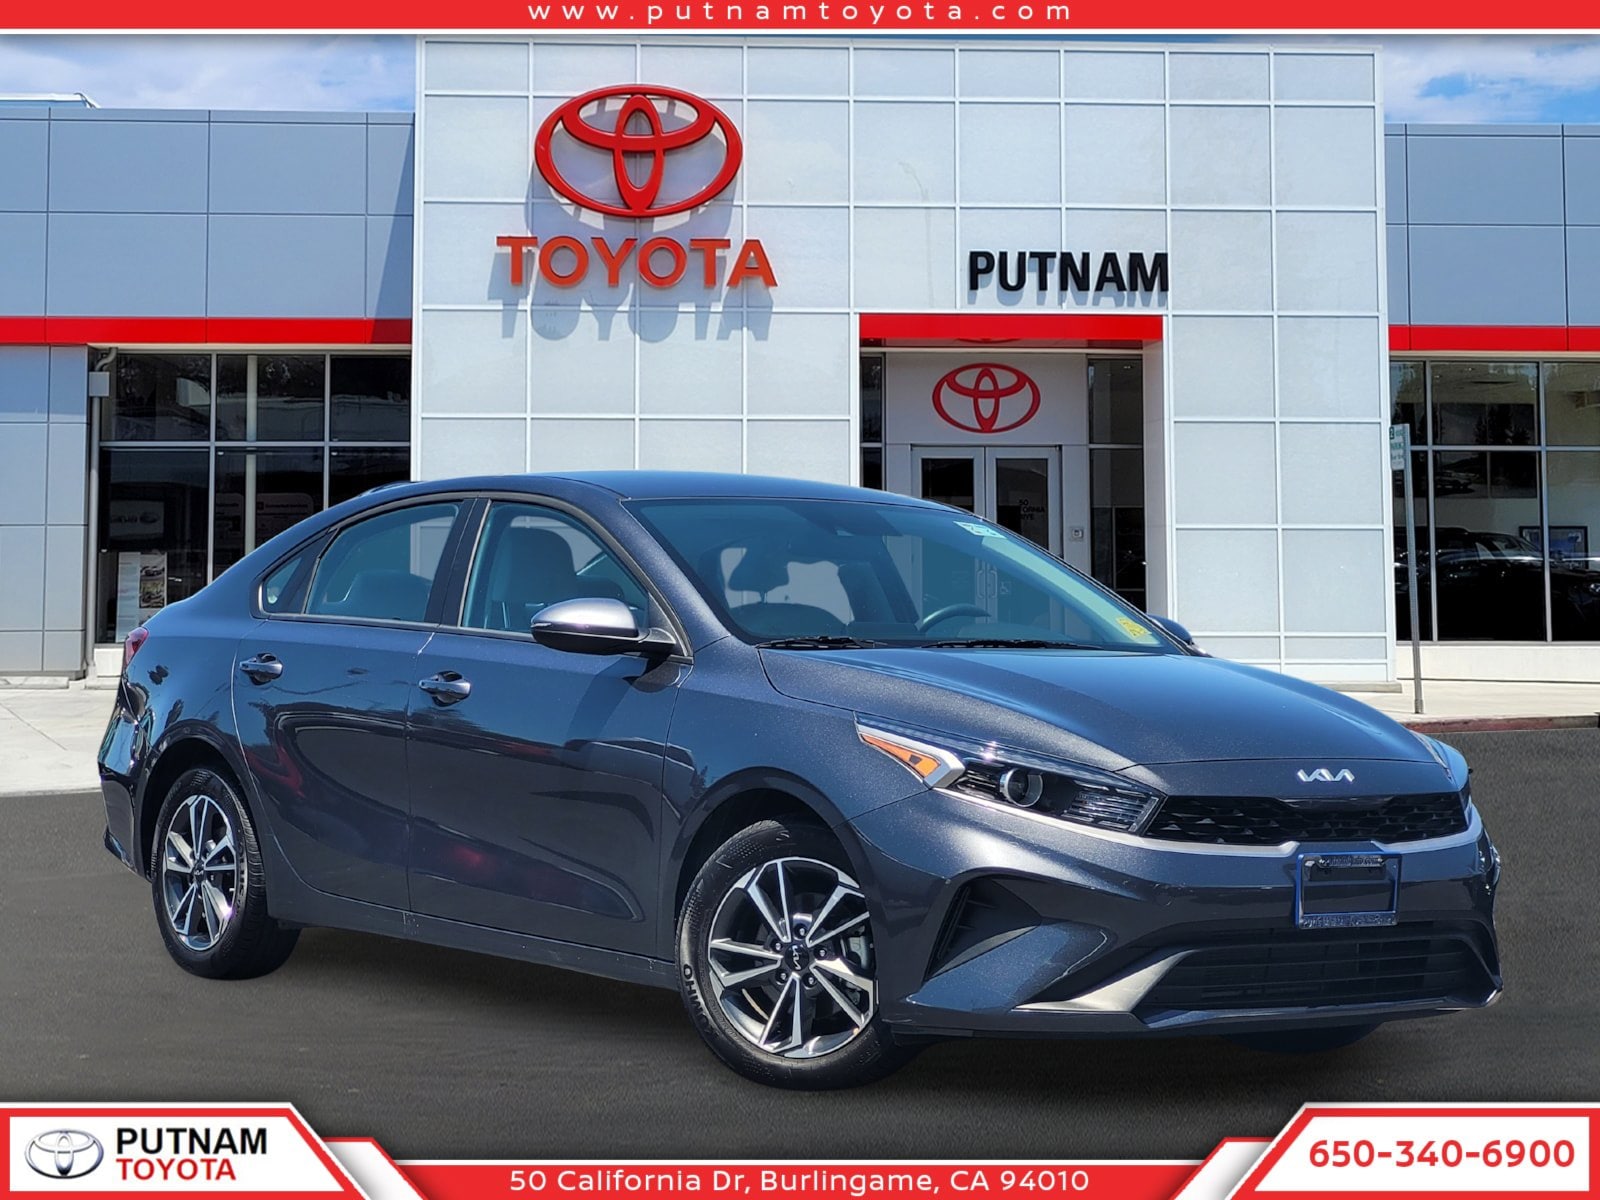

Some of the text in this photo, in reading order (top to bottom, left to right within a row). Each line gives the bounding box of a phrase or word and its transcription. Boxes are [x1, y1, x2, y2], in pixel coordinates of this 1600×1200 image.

[496, 236, 777, 288] TOYOTA
[969, 251, 1169, 293] PUTNAM
[1297, 769, 1355, 782] KIA
